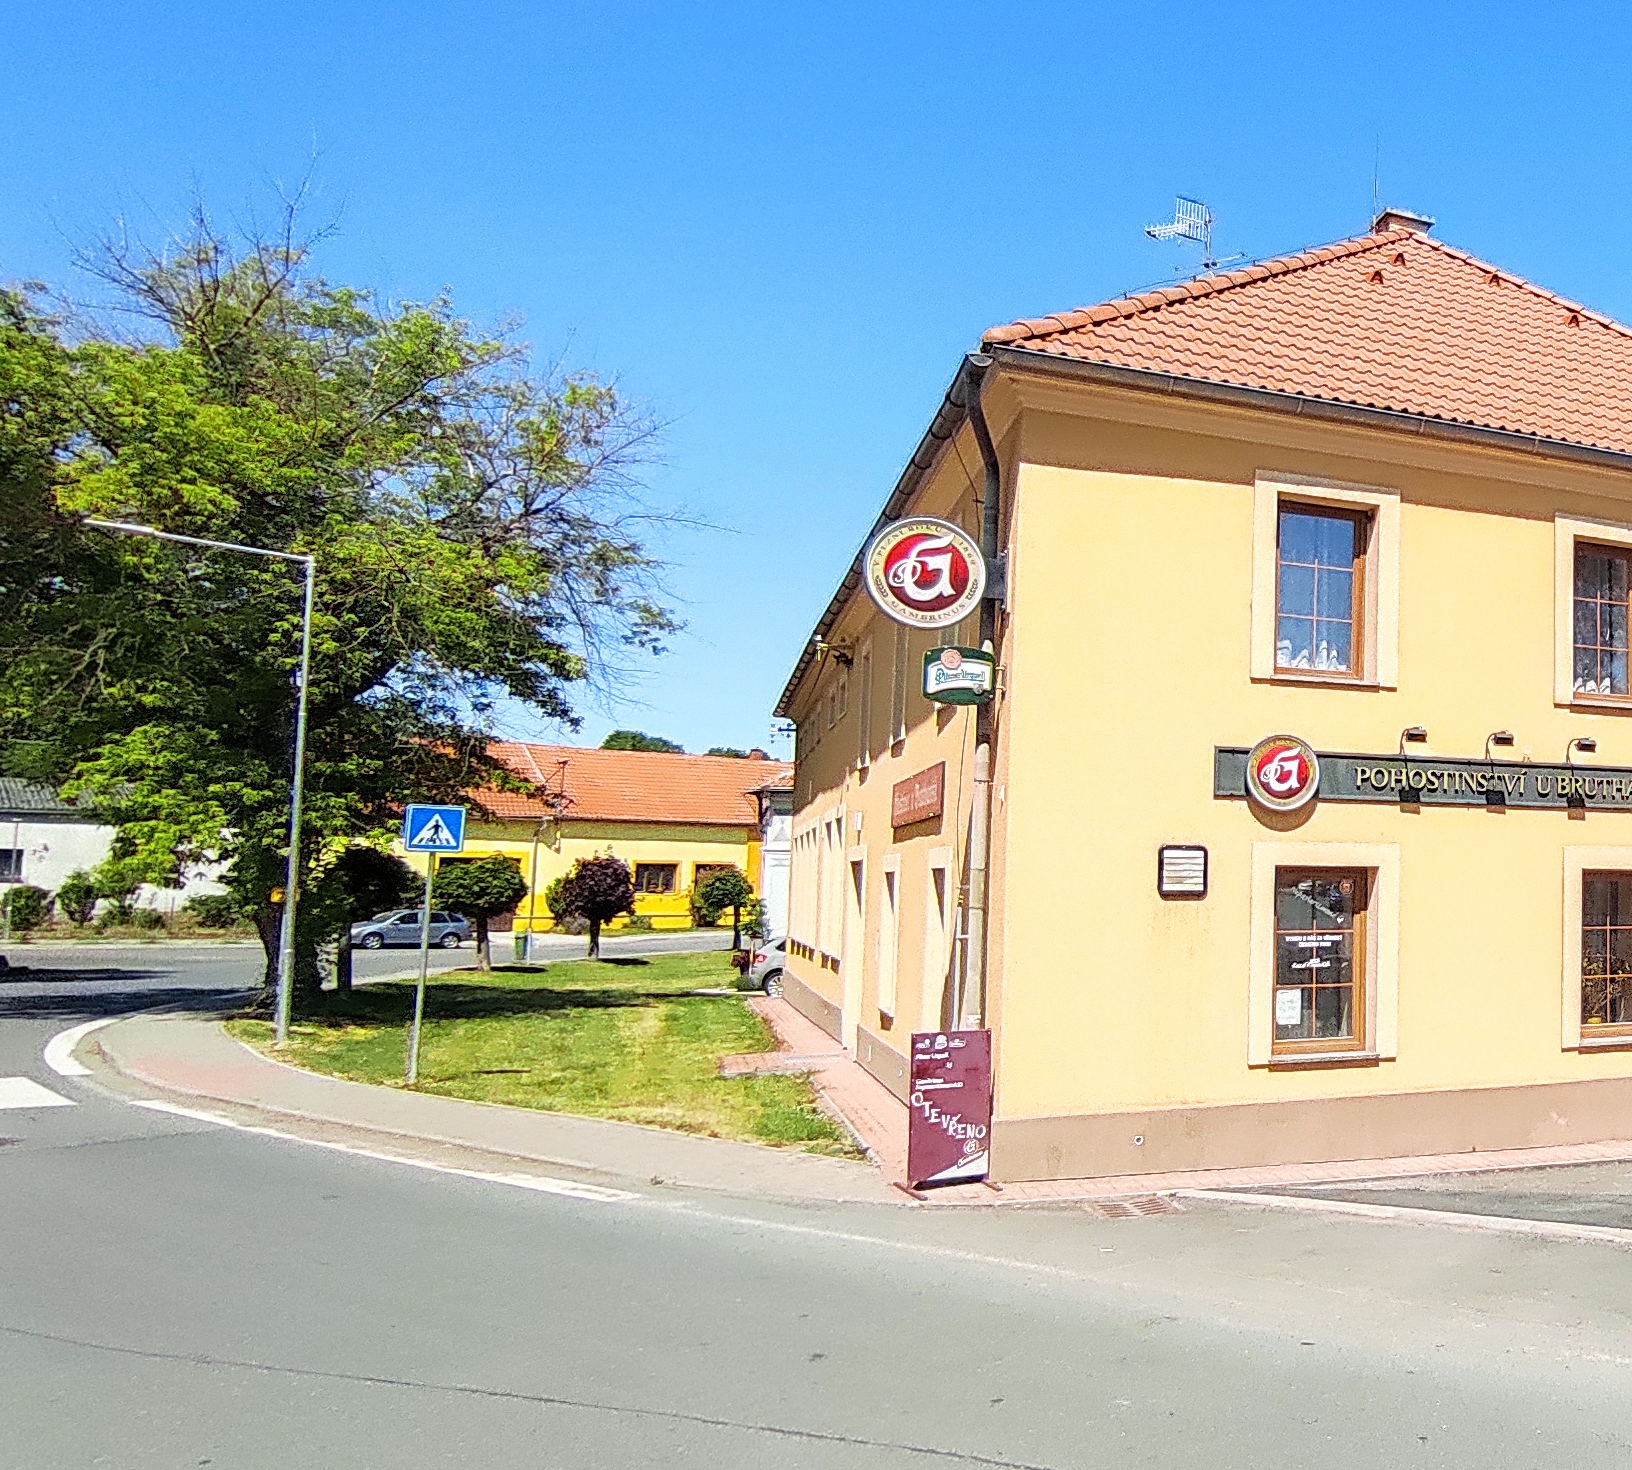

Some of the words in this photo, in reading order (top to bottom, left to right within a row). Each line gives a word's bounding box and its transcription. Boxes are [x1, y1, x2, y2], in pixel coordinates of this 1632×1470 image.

[891, 600, 966, 622] GAMBRINUS
[1355, 766, 1527, 795] POHOSTINSTVÍ
[1535, 774, 1551, 795] U
[911, 1092, 987, 1139] OTEVŘENO
